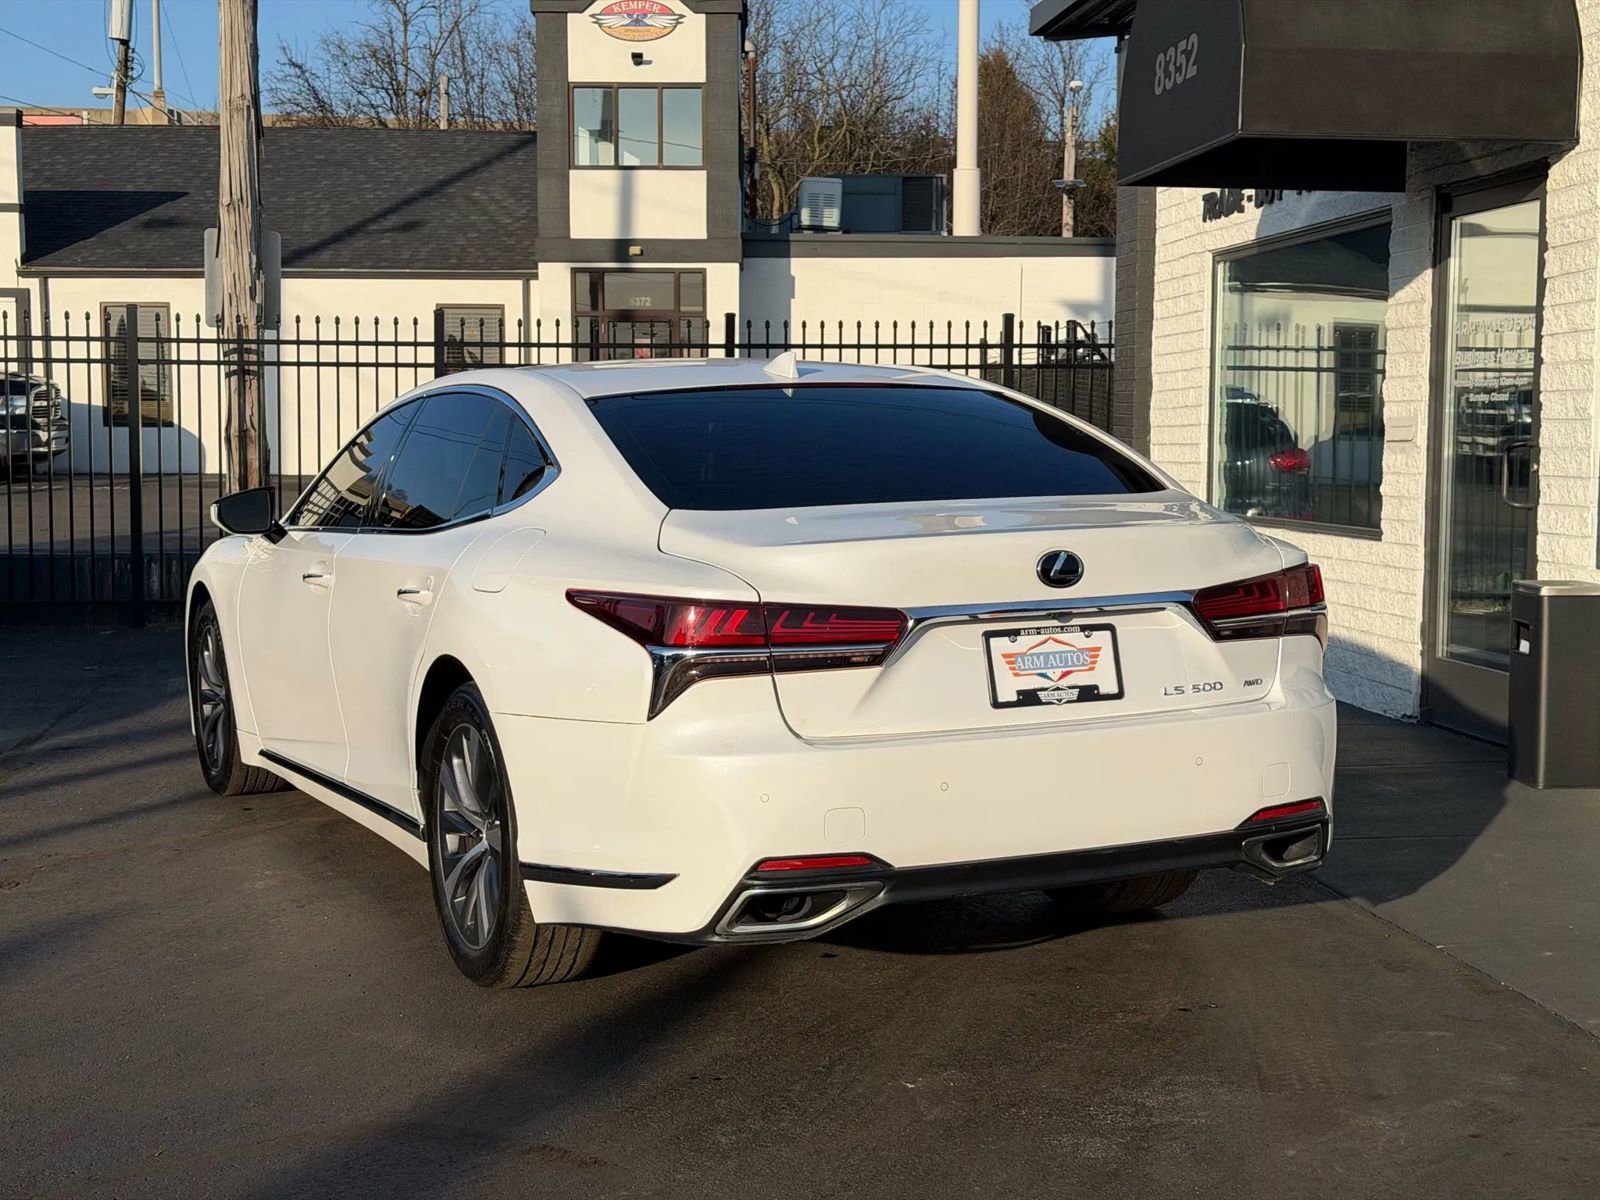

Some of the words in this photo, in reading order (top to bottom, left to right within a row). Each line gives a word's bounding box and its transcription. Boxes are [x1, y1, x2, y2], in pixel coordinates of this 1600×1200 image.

[611, 1, 661, 14] KEMPER
[1154, 32, 1199, 95] 8352
[1469, 392, 1490, 403] Sunday
[1490, 391, 1510, 402] Closed
[1019, 625, 1081, 636] arm-autos.com
[1016, 655, 1046, 670] ARM
[1047, 651, 1092, 668] AUTOS
[1163, 685, 1186, 696] LS
[1191, 681, 1224, 694] 500
[1242, 678, 1264, 688] AWD
